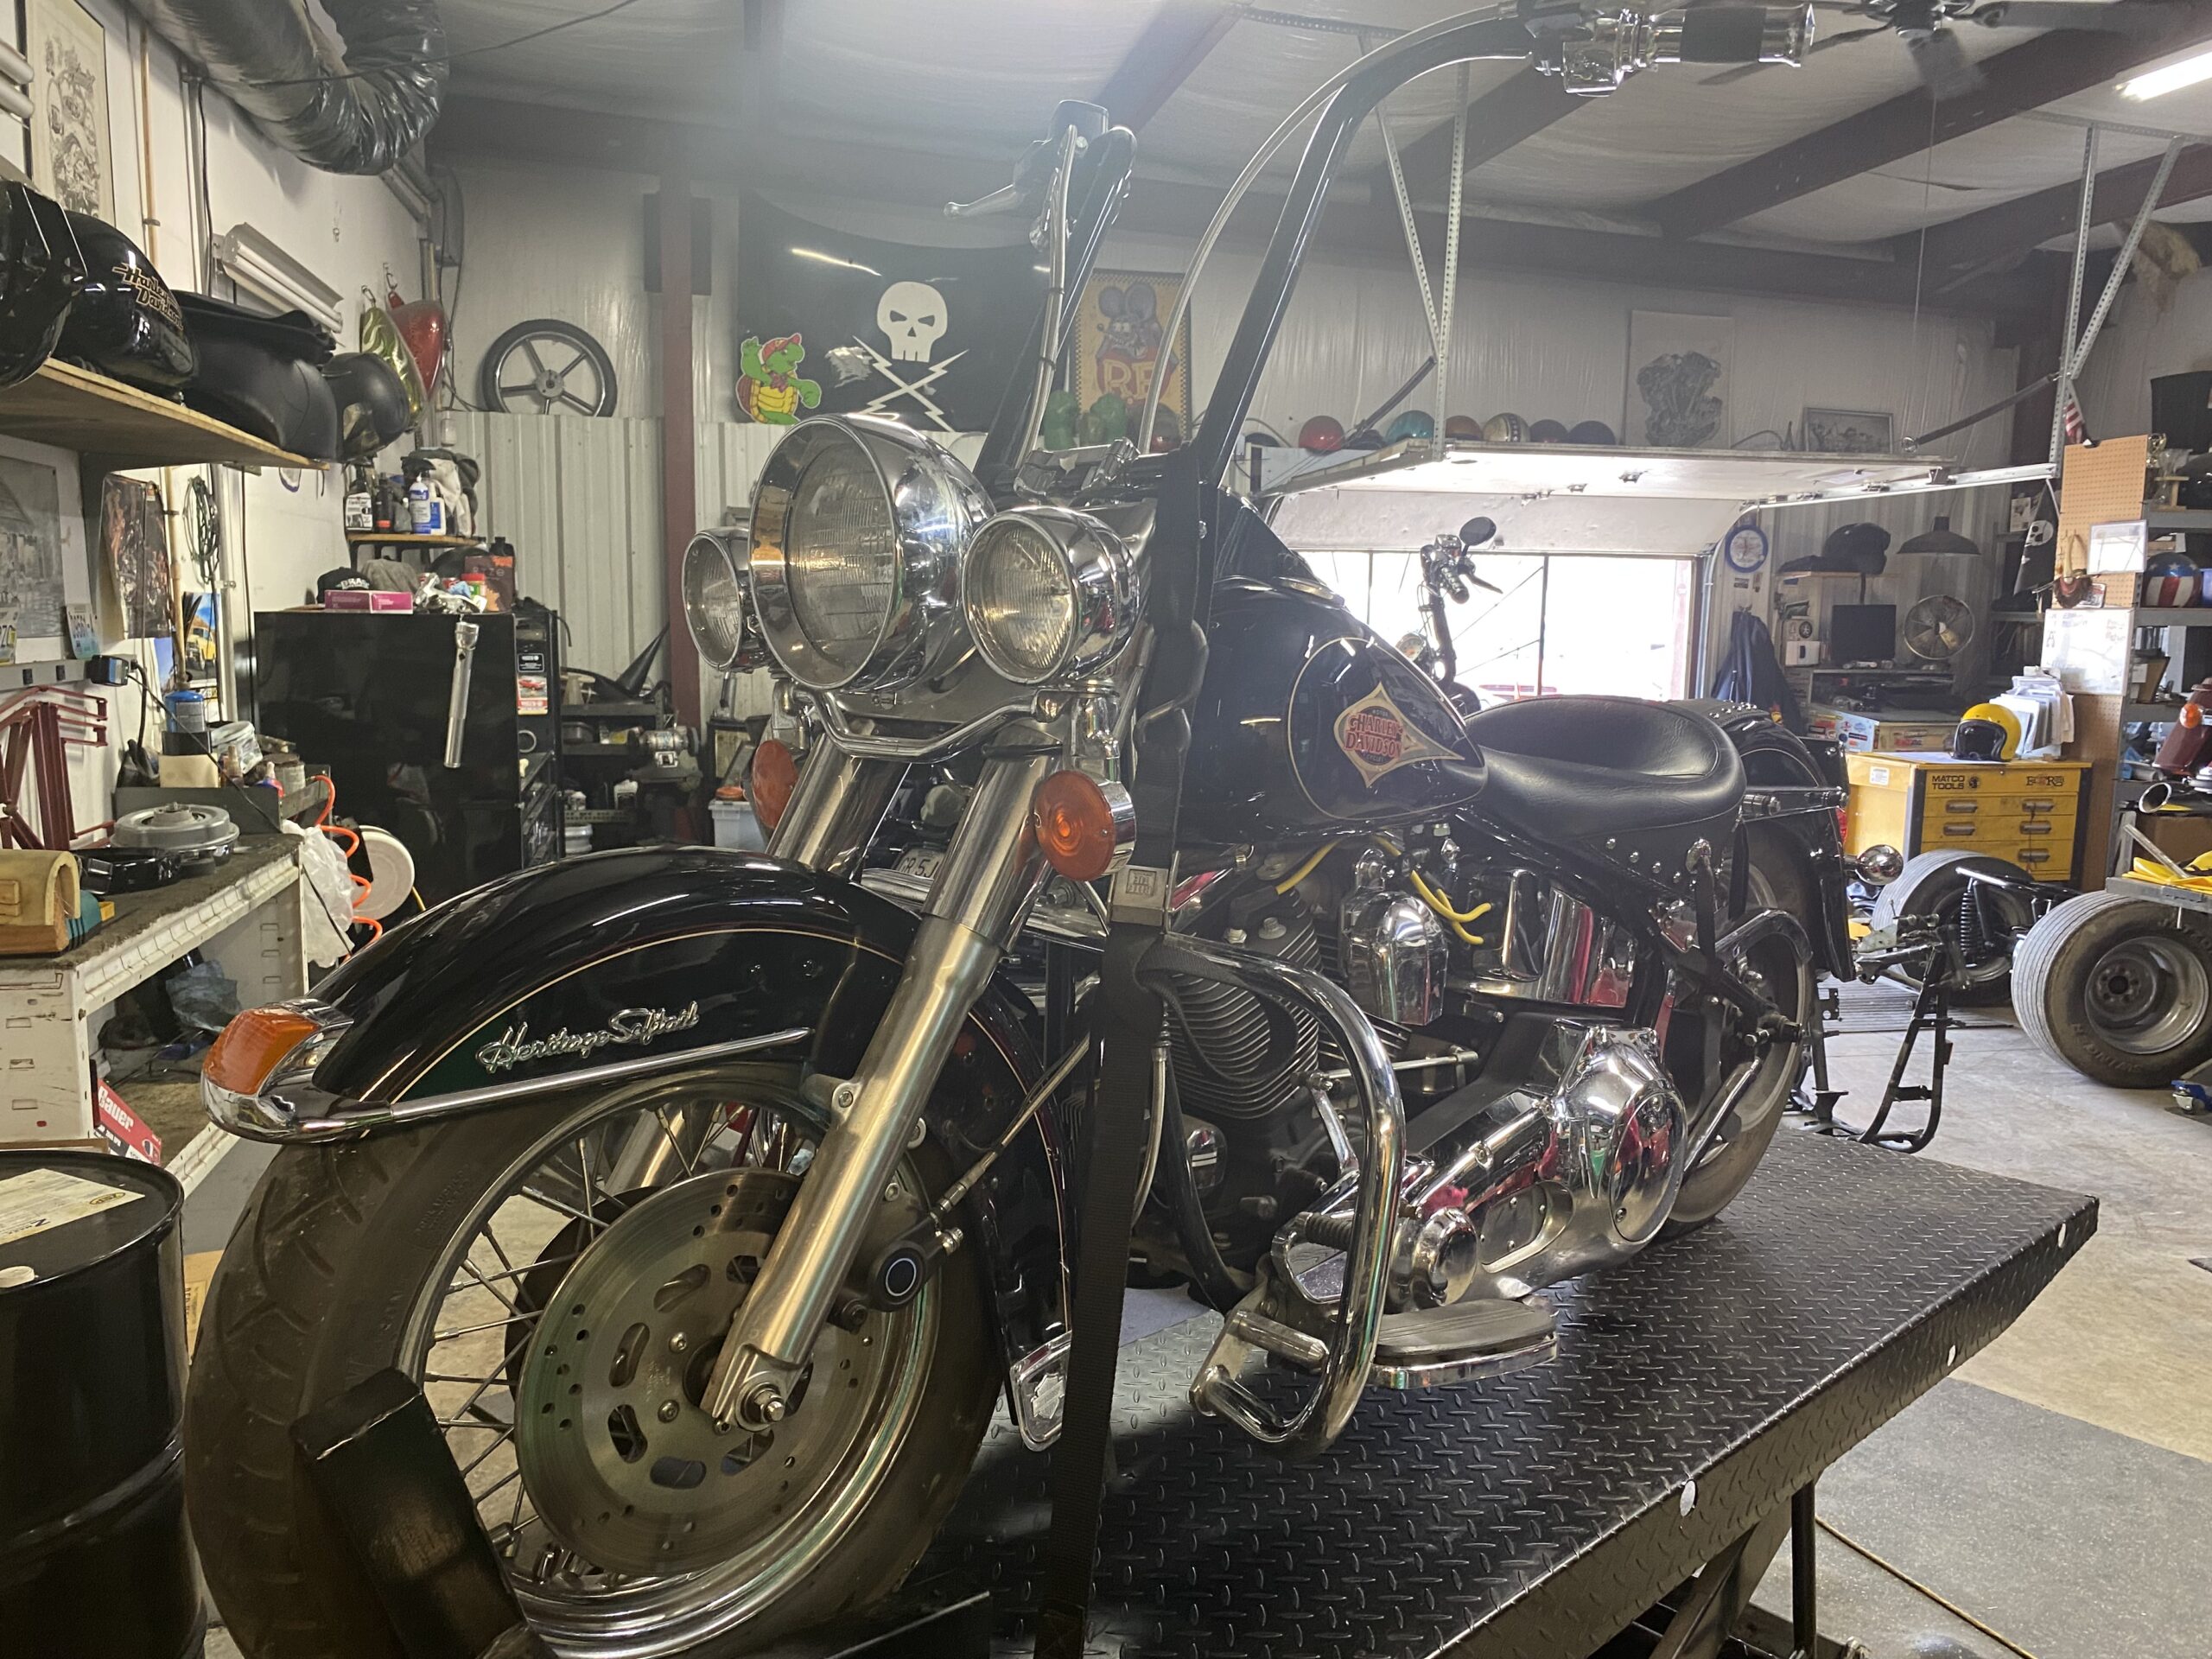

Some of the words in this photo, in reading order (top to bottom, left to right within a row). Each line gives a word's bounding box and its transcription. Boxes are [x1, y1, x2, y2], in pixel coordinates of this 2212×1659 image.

[112, 262, 174, 306] Harley
[136, 286, 184, 331] Davidson
[1344, 729, 1402, 760] DAVIDSON
[1348, 712, 1402, 740] HARLEY
[1931, 774, 1966, 783] MATCO
[475, 1020, 611, 1074] Heritage
[608, 1000, 700, 1046] Softail
[98, 1085, 135, 1133] Bauer
